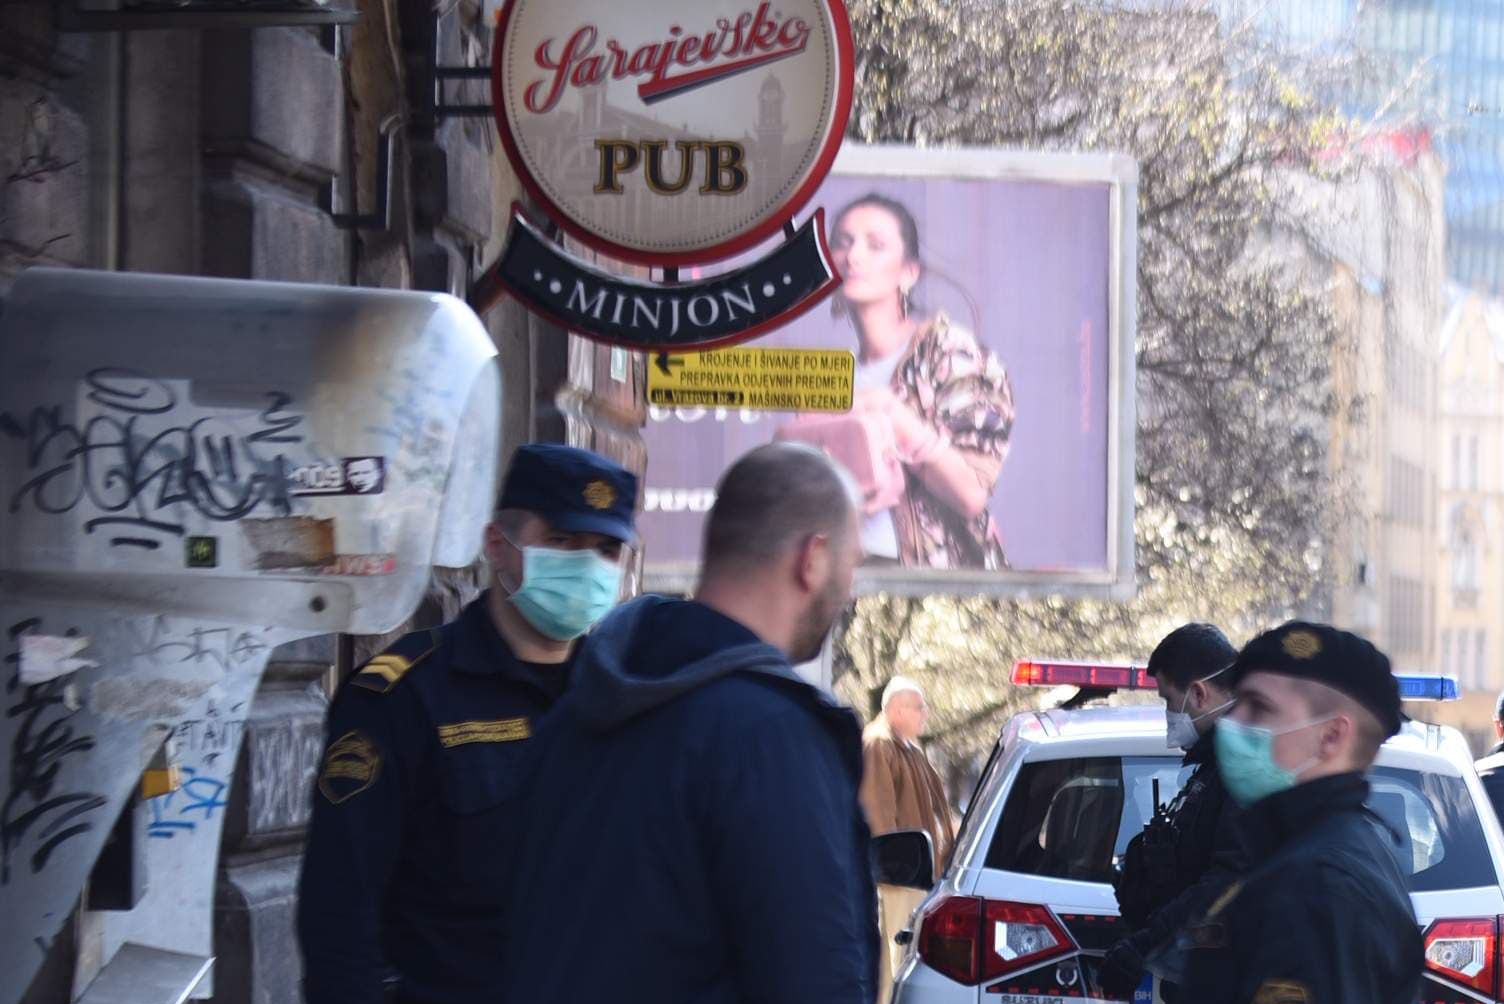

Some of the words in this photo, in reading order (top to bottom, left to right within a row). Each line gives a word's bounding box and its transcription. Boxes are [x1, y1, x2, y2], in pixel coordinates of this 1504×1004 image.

[523, 1, 812, 114] Sarajevsko
[593, 138, 748, 195] PUB
[565, 280, 756, 336] MINJON
[680, 370, 741, 387] PREPRAVKA
[743, 373, 793, 389] ODJEVNIH
[795, 375, 849, 389] PREDMETA
[700, 352, 751, 369] KROJENJE
[803, 356, 817, 370] PO
[820, 357, 850, 371] MJERI
[803, 395, 850, 410] VEZENJE
